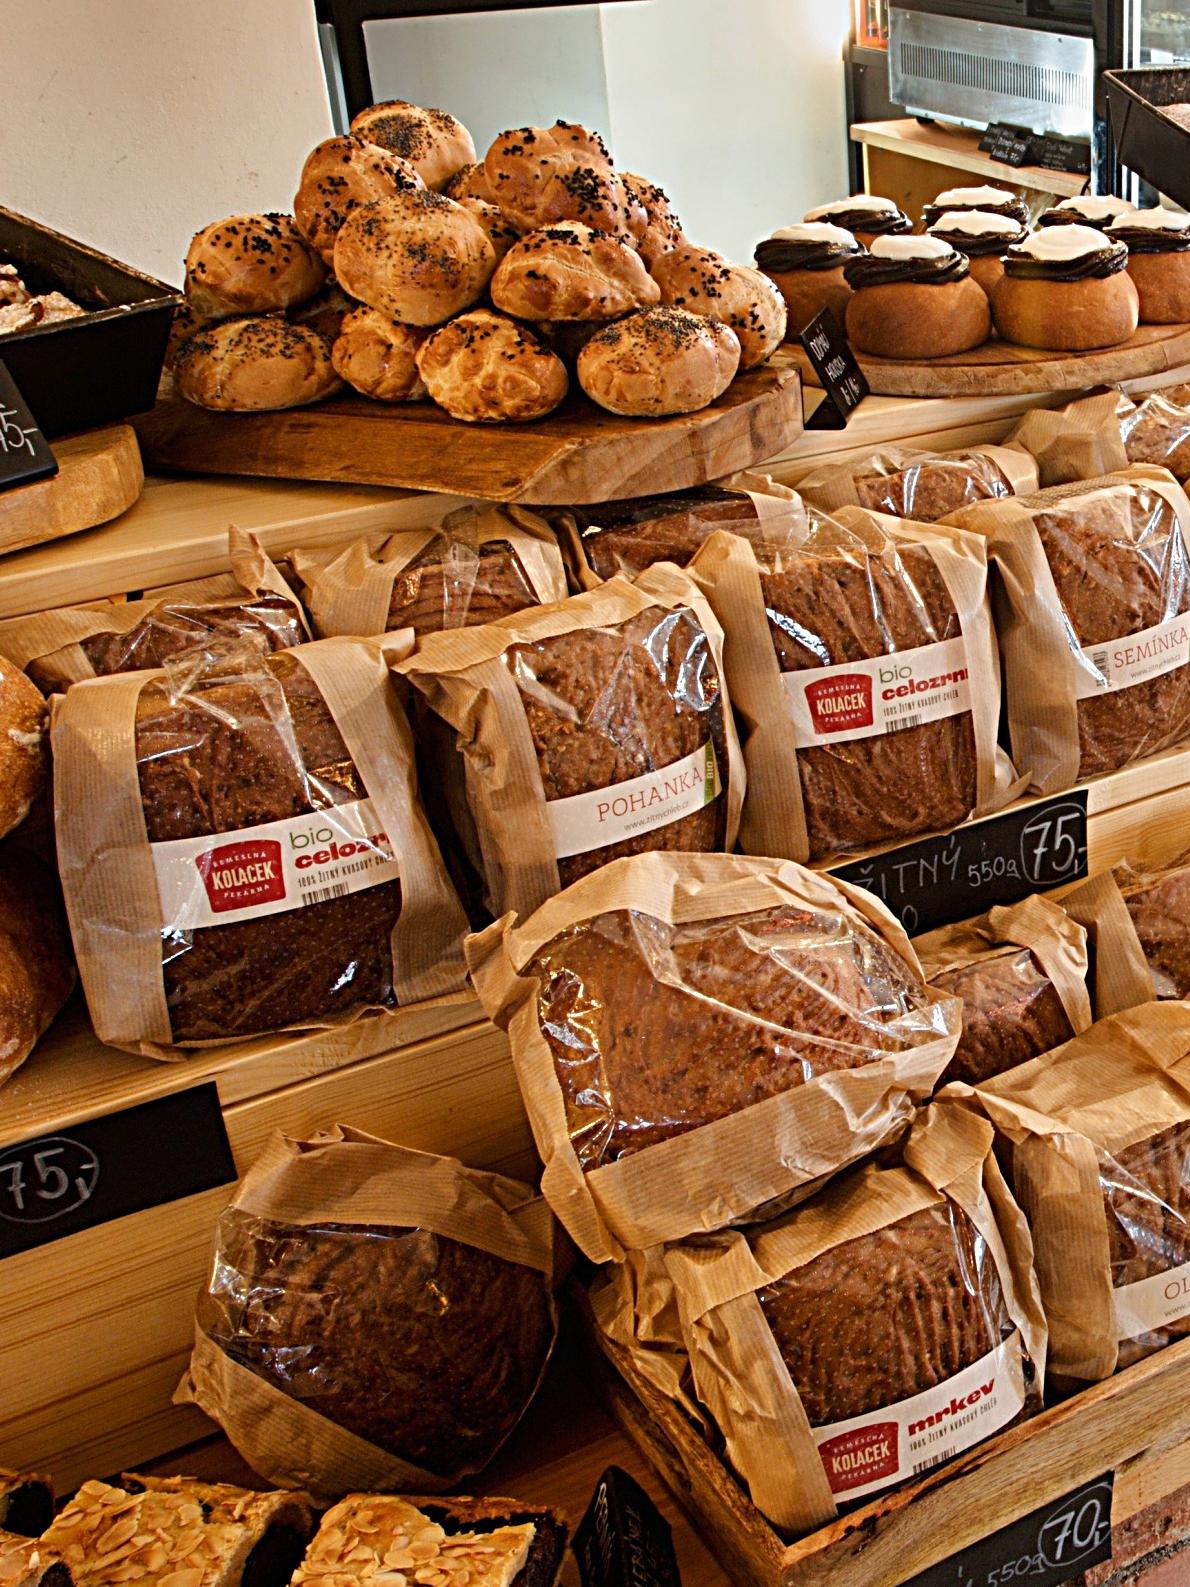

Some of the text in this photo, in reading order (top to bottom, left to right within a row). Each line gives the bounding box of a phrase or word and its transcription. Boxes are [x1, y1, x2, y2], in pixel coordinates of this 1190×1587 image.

[1114, 627, 1189, 669] SEMÍNKA
[879, 665, 912, 684] bio
[881, 667, 968, 701] celozrn
[596, 767, 703, 823] POHANKA
[289, 827, 334, 850] bio
[967, 856, 1022, 888] 550g
[908, 1377, 995, 1437] mrkev
